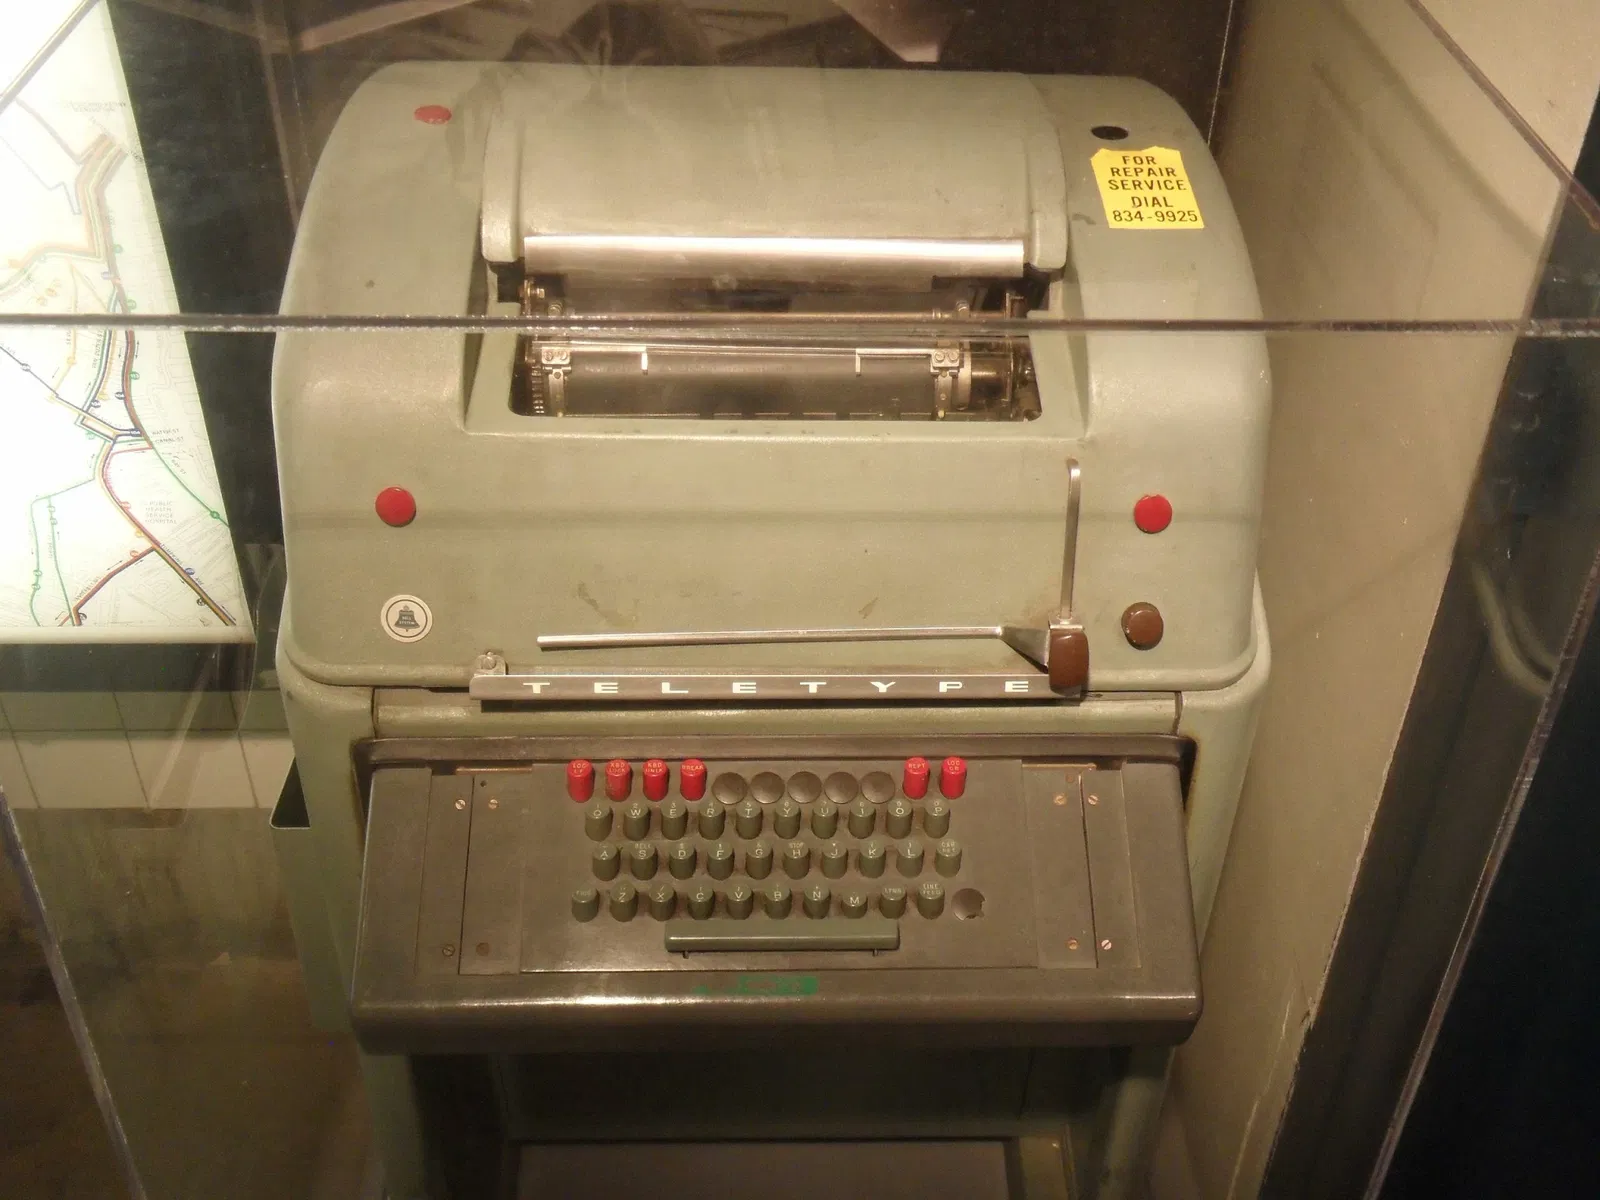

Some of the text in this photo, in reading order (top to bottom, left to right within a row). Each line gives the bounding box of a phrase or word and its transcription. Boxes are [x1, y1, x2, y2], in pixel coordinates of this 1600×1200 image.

[1121, 155, 1157, 165] FOR
[1110, 167, 1177, 177] REPAIR
[1108, 179, 1187, 191] SERVICE
[1130, 196, 1174, 208] DIAL
[1112, 209, 1198, 223] 834-9925
[522, 680, 1030, 694] TELETYPE
[630, 808, 641, 816] W
[669, 808, 677, 816] E
[638, 849, 647, 857] S
[678, 849, 686, 857] D
[755, 849, 763, 857] G
[830, 848, 838, 856] J
[868, 848, 876, 856] K
[907, 848, 915, 856] L
[618, 892, 626, 900] Z
[656, 892, 665, 900] X
[696, 892, 704, 900] C
[774, 891, 782, 899] B
[812, 891, 821, 899] N
[849, 896, 860, 904] M
